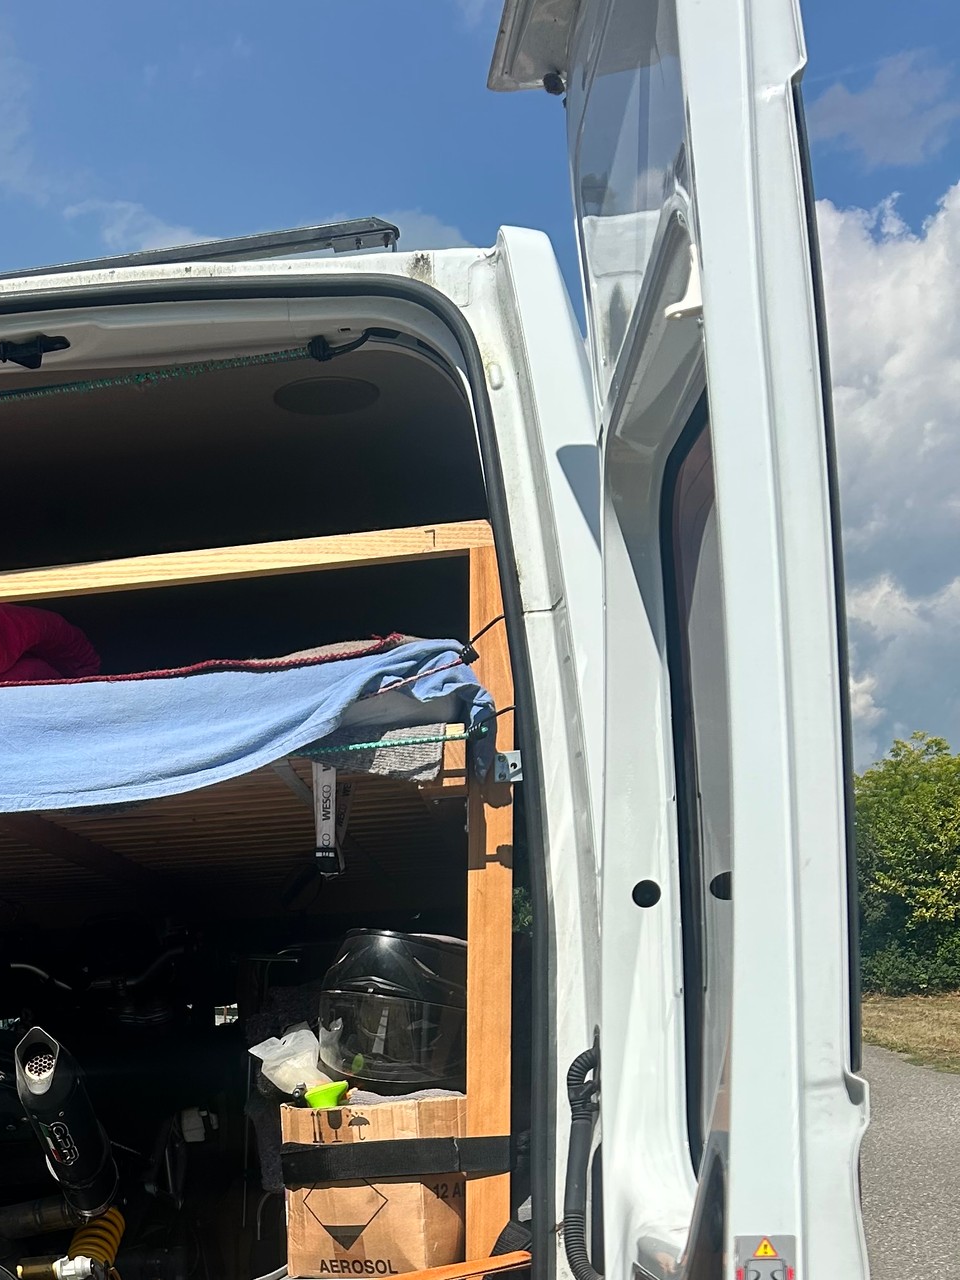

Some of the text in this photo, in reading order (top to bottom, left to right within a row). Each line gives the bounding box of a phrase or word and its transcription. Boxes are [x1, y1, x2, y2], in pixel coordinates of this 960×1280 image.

[322, 784, 332, 821] WESCO
[433, 1183, 448, 1199] 12
[320, 1259, 399, 1274] AEROSOL
